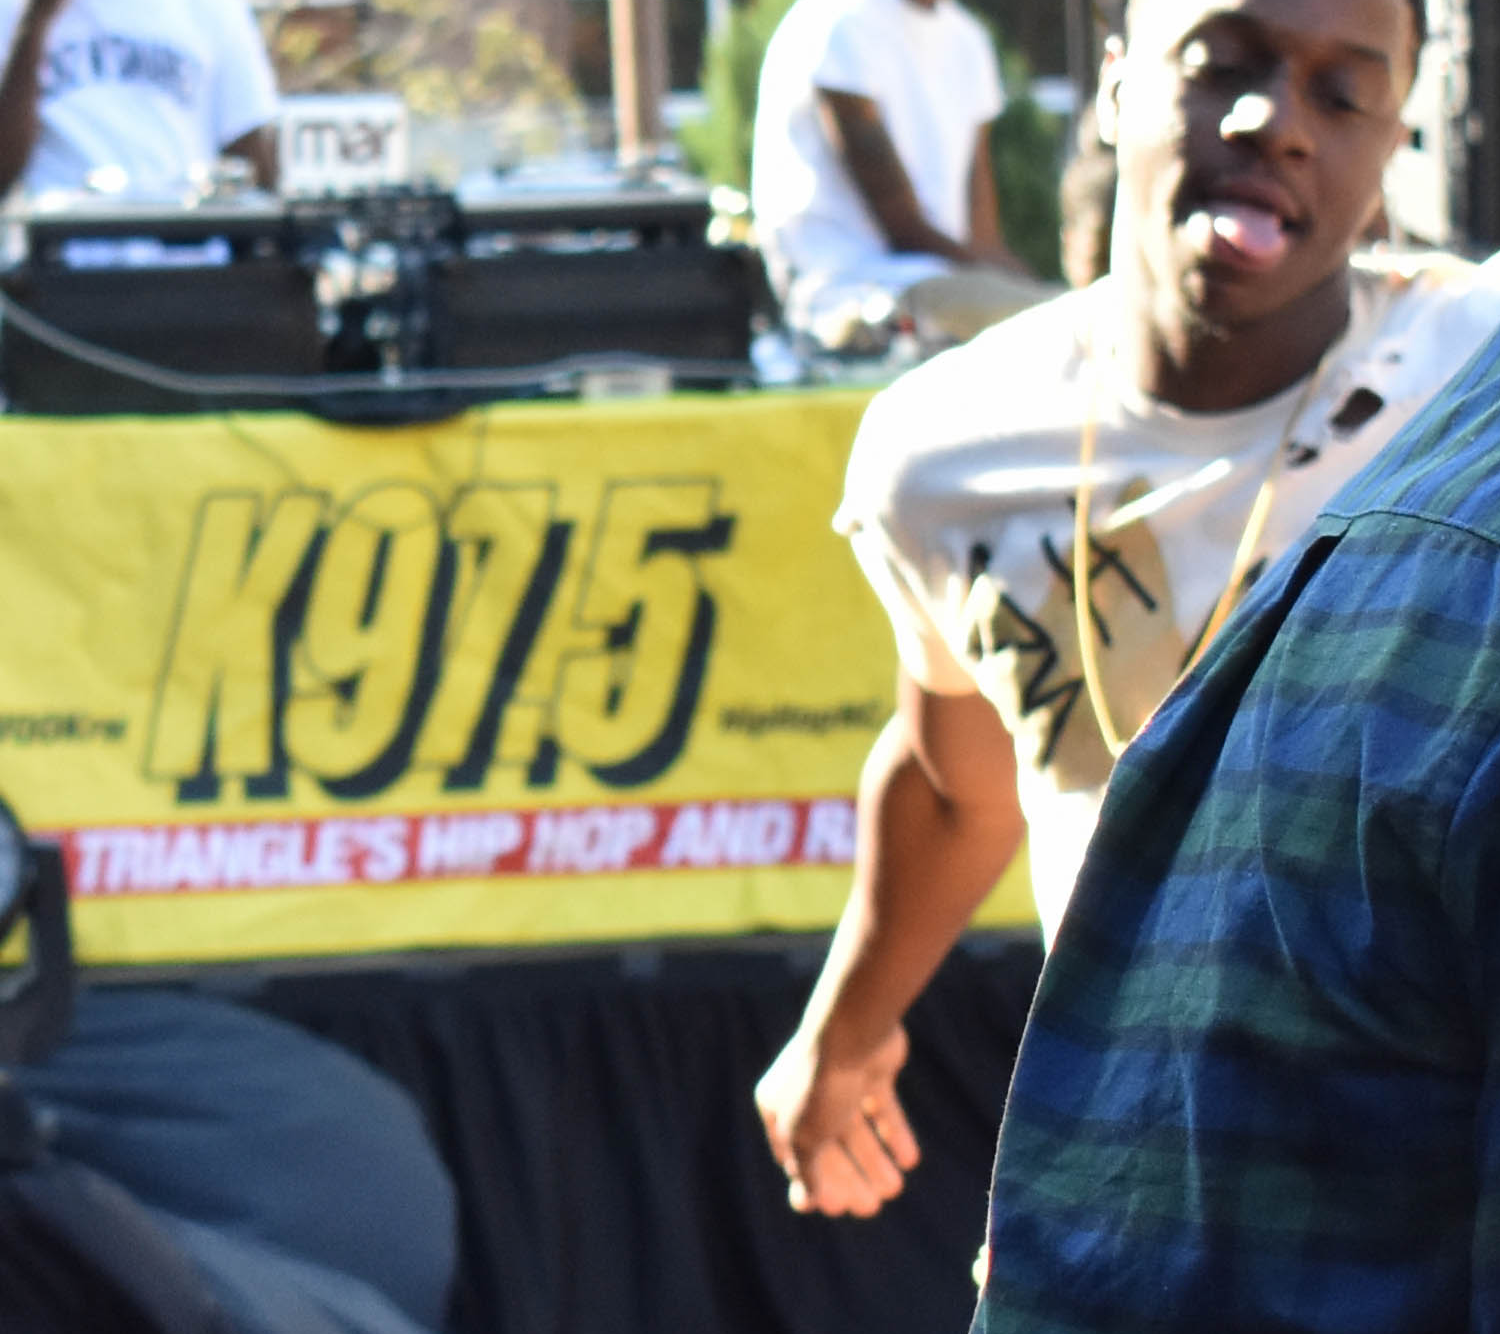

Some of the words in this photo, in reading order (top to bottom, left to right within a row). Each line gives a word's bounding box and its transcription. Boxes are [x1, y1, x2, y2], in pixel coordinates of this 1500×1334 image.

[142, 477, 738, 803] K97.5
[73, 815, 409, 897] TRIANGLE'S
[416, 808, 524, 878] HIP
[524, 804, 658, 875] HOP
[659, 798, 796, 868] AND
